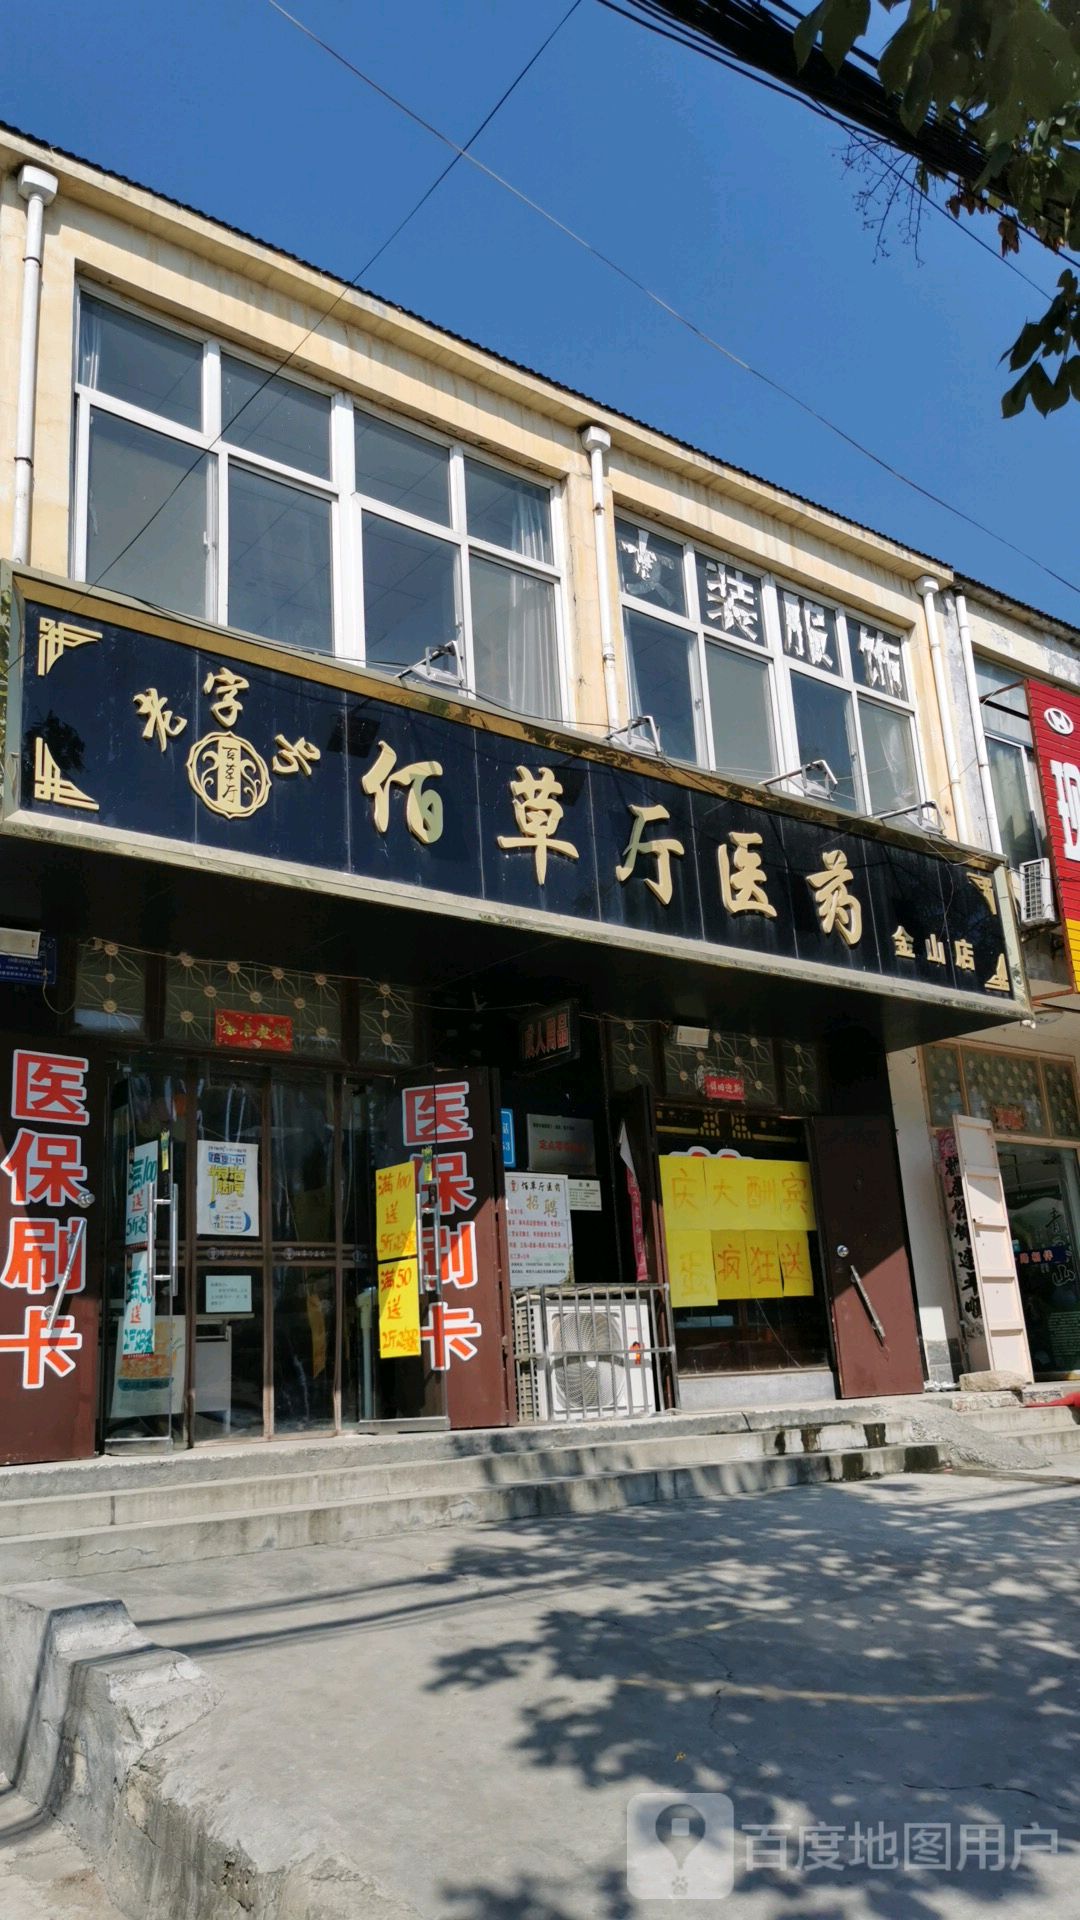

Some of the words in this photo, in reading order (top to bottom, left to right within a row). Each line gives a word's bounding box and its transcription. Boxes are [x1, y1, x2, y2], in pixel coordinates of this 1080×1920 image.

[133, 667, 321, 776] 老字号
[361, 740, 863, 947] 佰草厅医药
[891, 925, 976, 972] 金山店
[378, 1171, 412, 1196] 满100
[521, 1180, 561, 1192] 佰草厅医药
[670, 1168, 811, 1214] 庆大酬宾
[385, 1199, 399, 1225] 送
[526, 1194, 559, 1217] 招聘
[0, 1049, 90, 1389] 医保刷卡
[381, 1266, 412, 1292] 满50
[387, 1294, 402, 1320] 送
